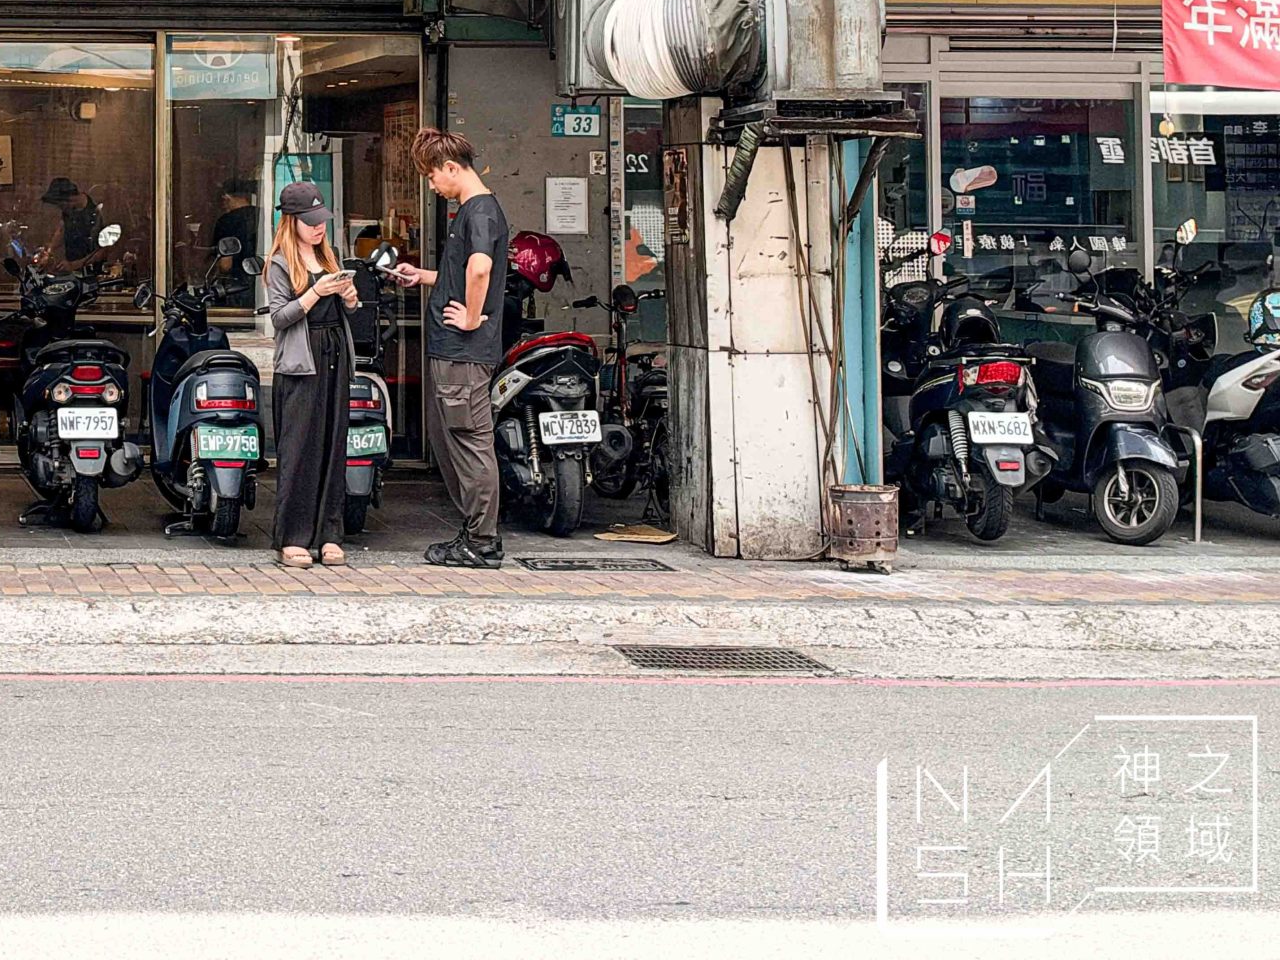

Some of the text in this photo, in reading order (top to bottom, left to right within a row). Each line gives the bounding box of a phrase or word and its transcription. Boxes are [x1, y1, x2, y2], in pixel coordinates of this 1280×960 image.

[572, 116, 593, 133] 33
[60, 416, 114, 431] NWF-7957
[542, 419, 597, 437] MCV-2839
[971, 420, 1029, 436] MXN-5682
[200, 435, 257, 452] EWP-9758
[347, 432, 383, 449] -8677
